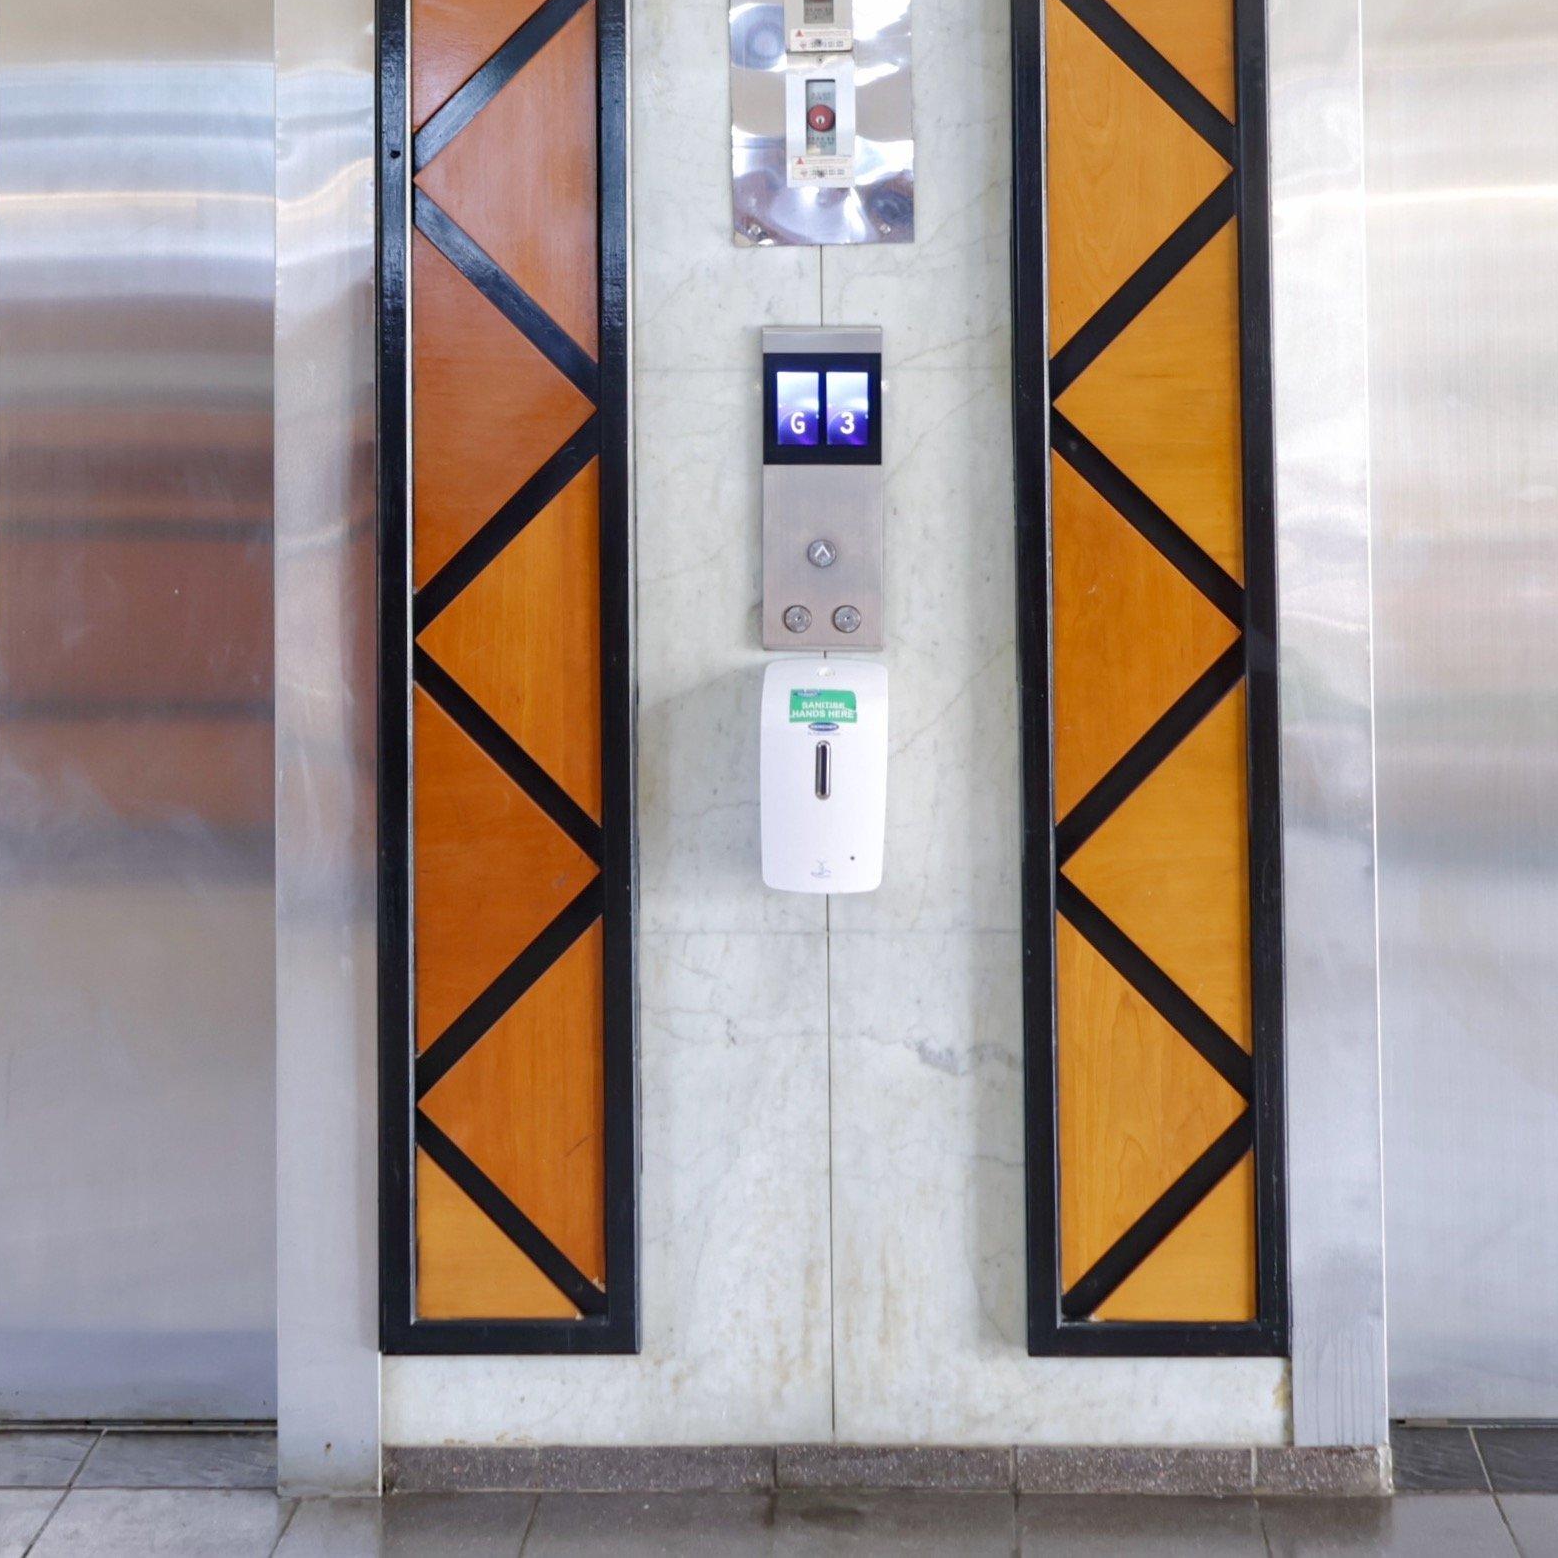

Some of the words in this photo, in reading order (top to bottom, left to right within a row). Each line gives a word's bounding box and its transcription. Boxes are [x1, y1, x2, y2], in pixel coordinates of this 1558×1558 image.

[790, 411, 806, 435] G
[839, 411, 855, 435] 3
[792, 709, 826, 718] HANDS
[827, 709, 854, 719] HERE
